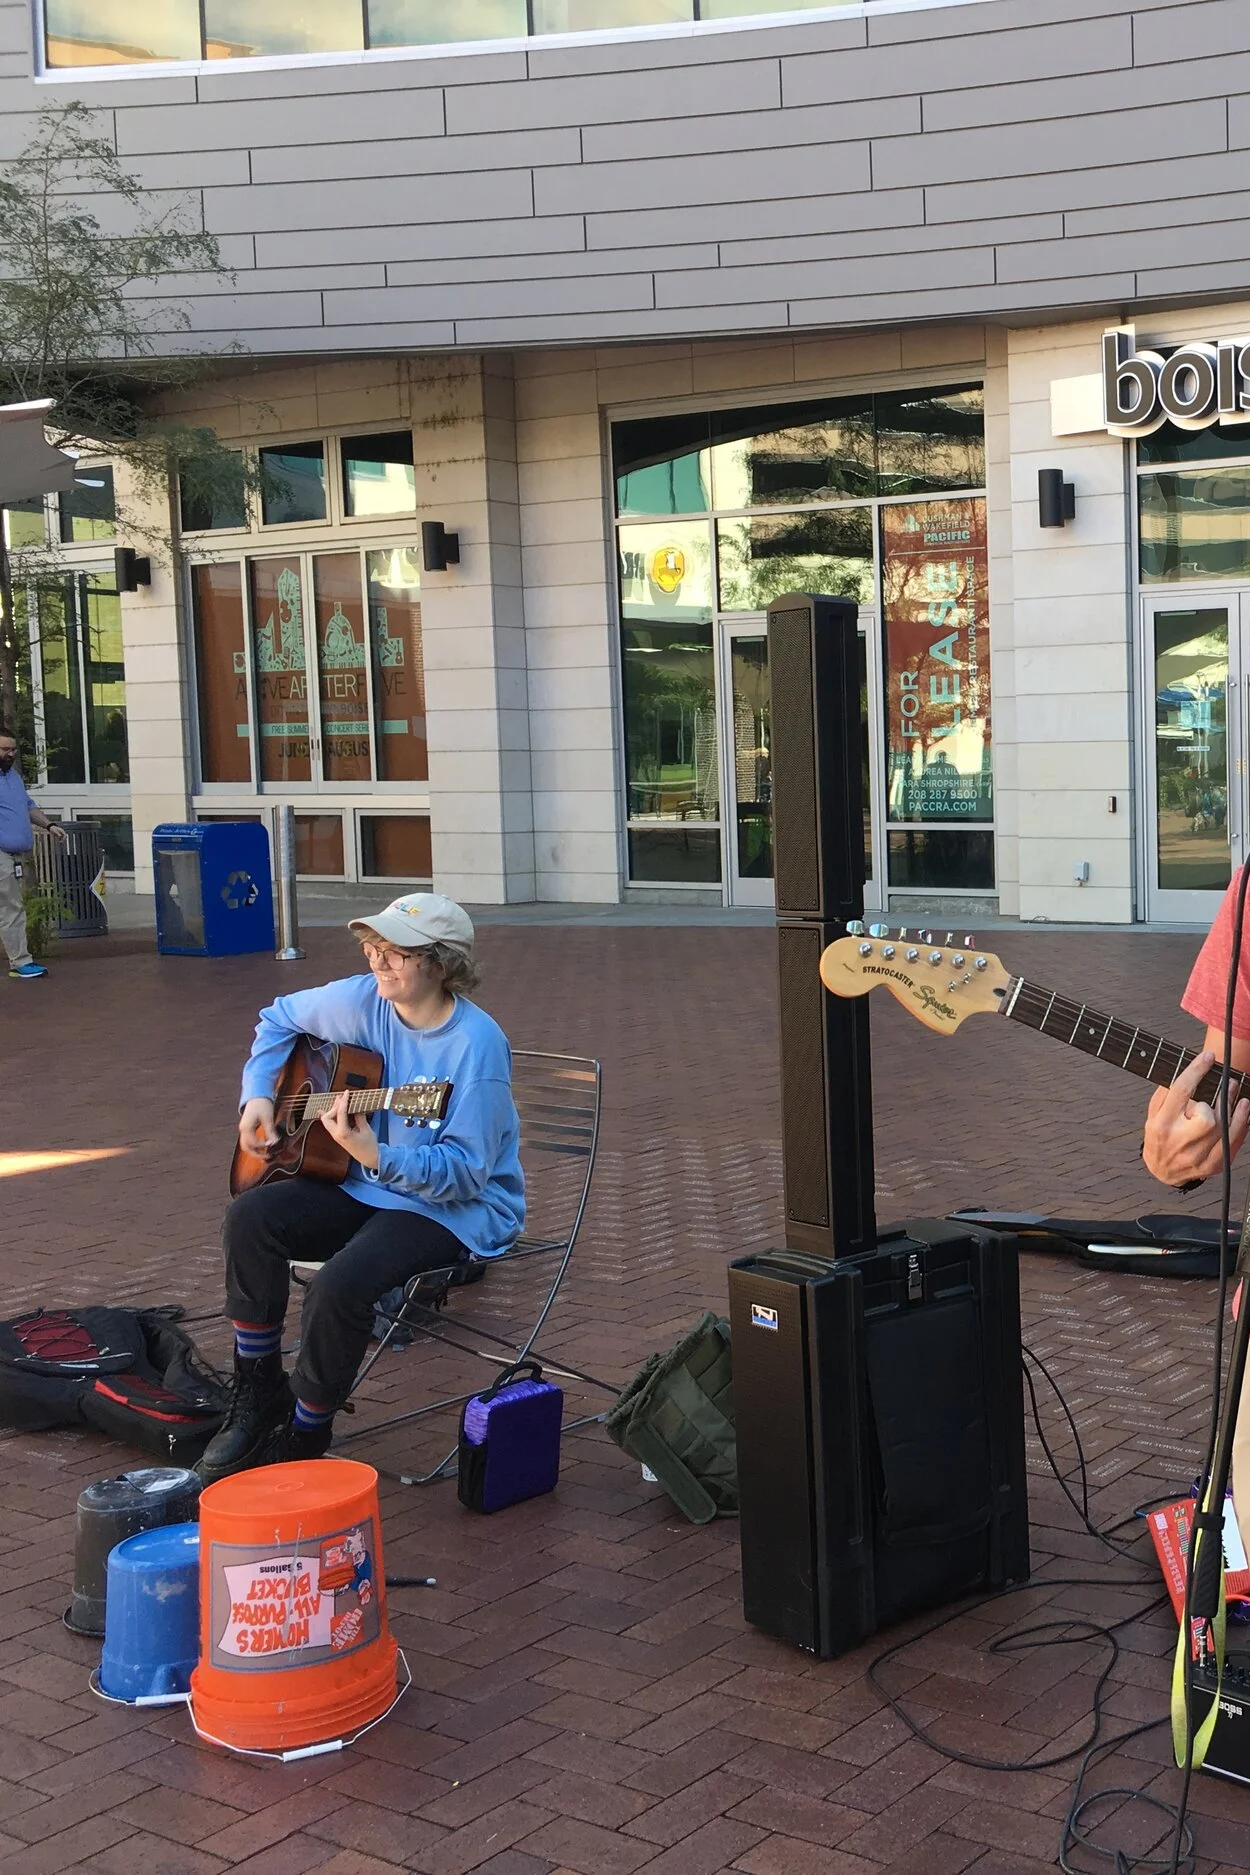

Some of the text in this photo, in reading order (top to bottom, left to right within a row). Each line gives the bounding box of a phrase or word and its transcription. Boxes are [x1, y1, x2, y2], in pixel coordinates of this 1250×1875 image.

[922, 521, 970, 531] WAKEFIELD
[924, 531, 970, 542] PACIFIC
[966, 556, 975, 596] SPACE
[928, 562, 960, 737] LEASE
[901, 670, 920, 737] FOR
[287, 723, 309, 733] SUMME
[327, 741, 370, 757] AUGUS
[908, 768, 942, 776] ADREA
[908, 790, 977, 799] 208 287 9500
[909, 801, 977, 811] PACCRA.COM
[863, 966, 914, 989] STRATOCASTER
[297, 1562, 303, 1571] 5
[247, 1572, 311, 1600] BUCKET
